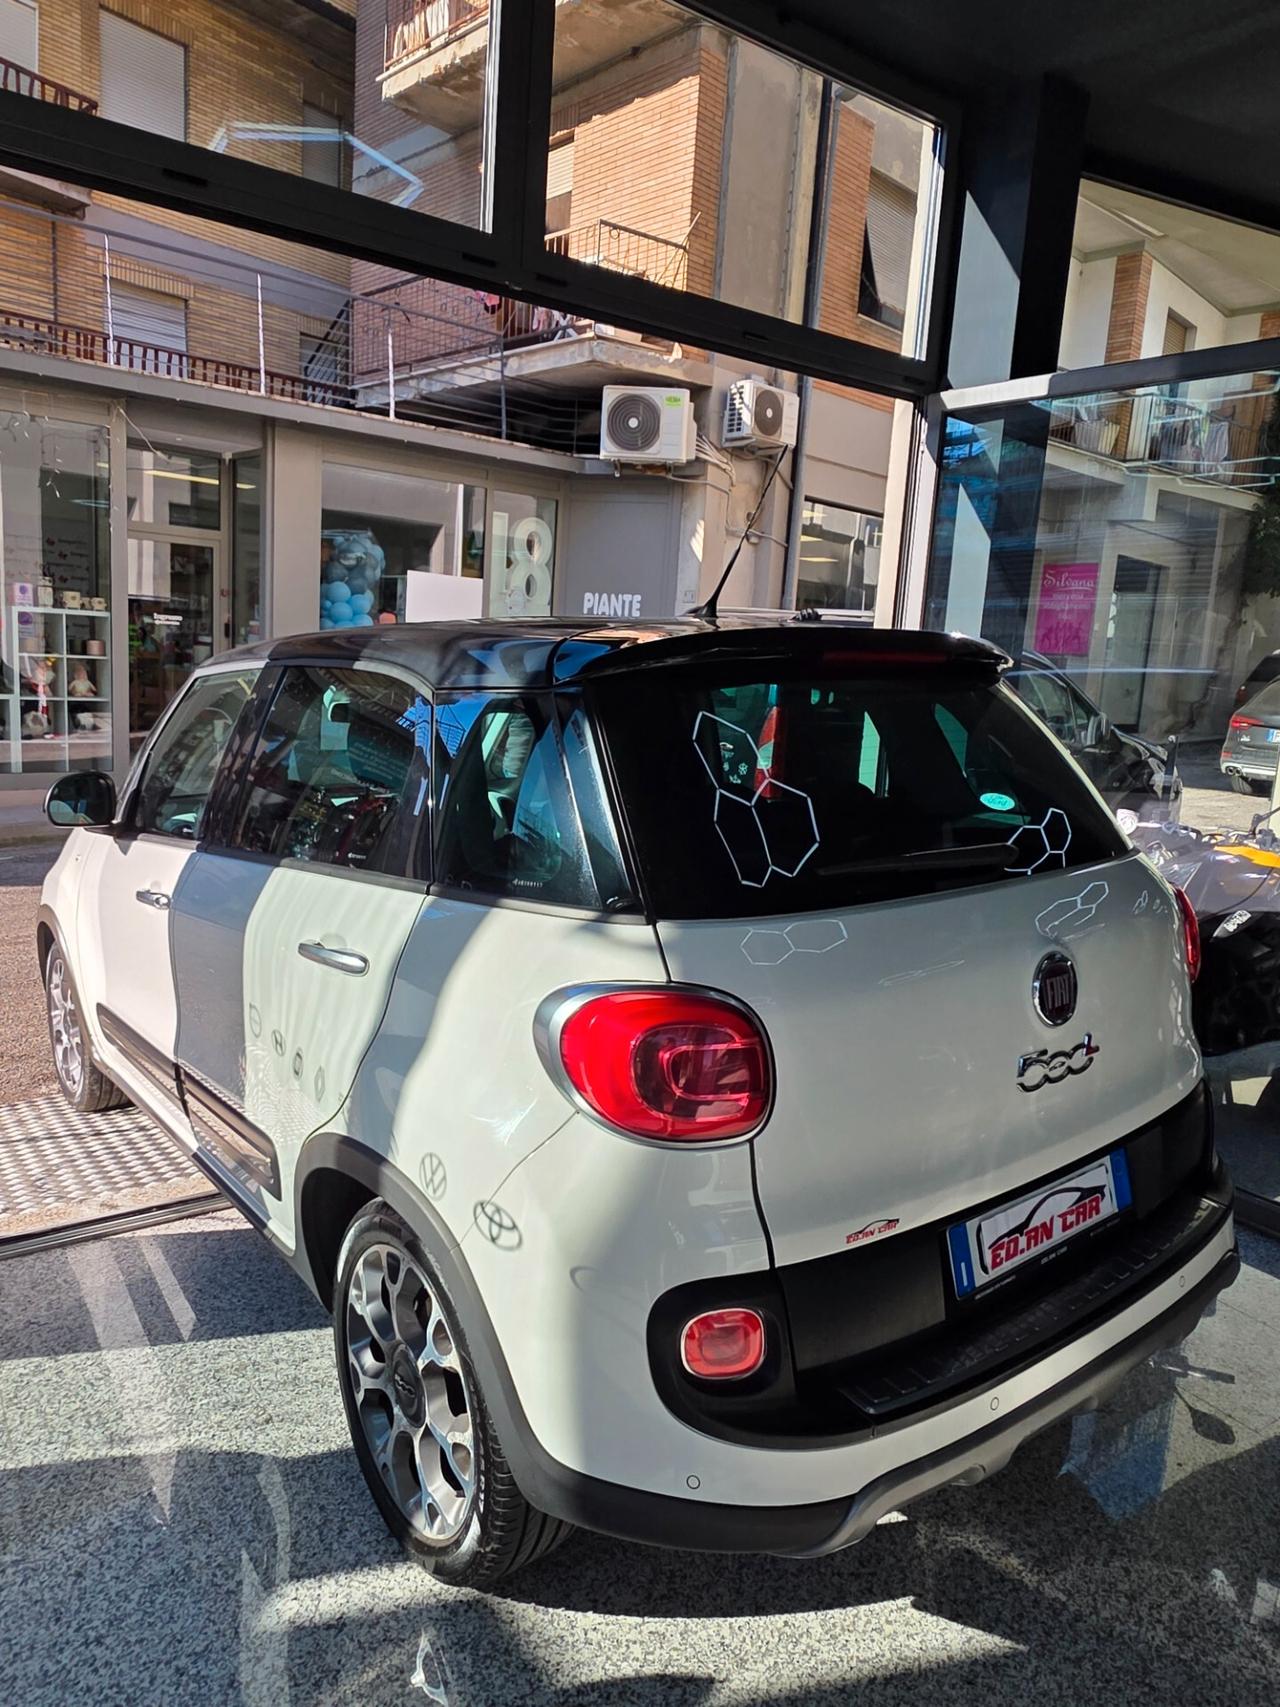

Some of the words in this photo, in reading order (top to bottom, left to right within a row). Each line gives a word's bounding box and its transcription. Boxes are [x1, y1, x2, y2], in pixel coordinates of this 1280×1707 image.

[1043, 569, 1095, 588] Silvana
[583, 592, 642, 617] PIANTE
[1045, 973, 1072, 1009] FIAT
[1057, 1194, 1102, 1234] CAR
